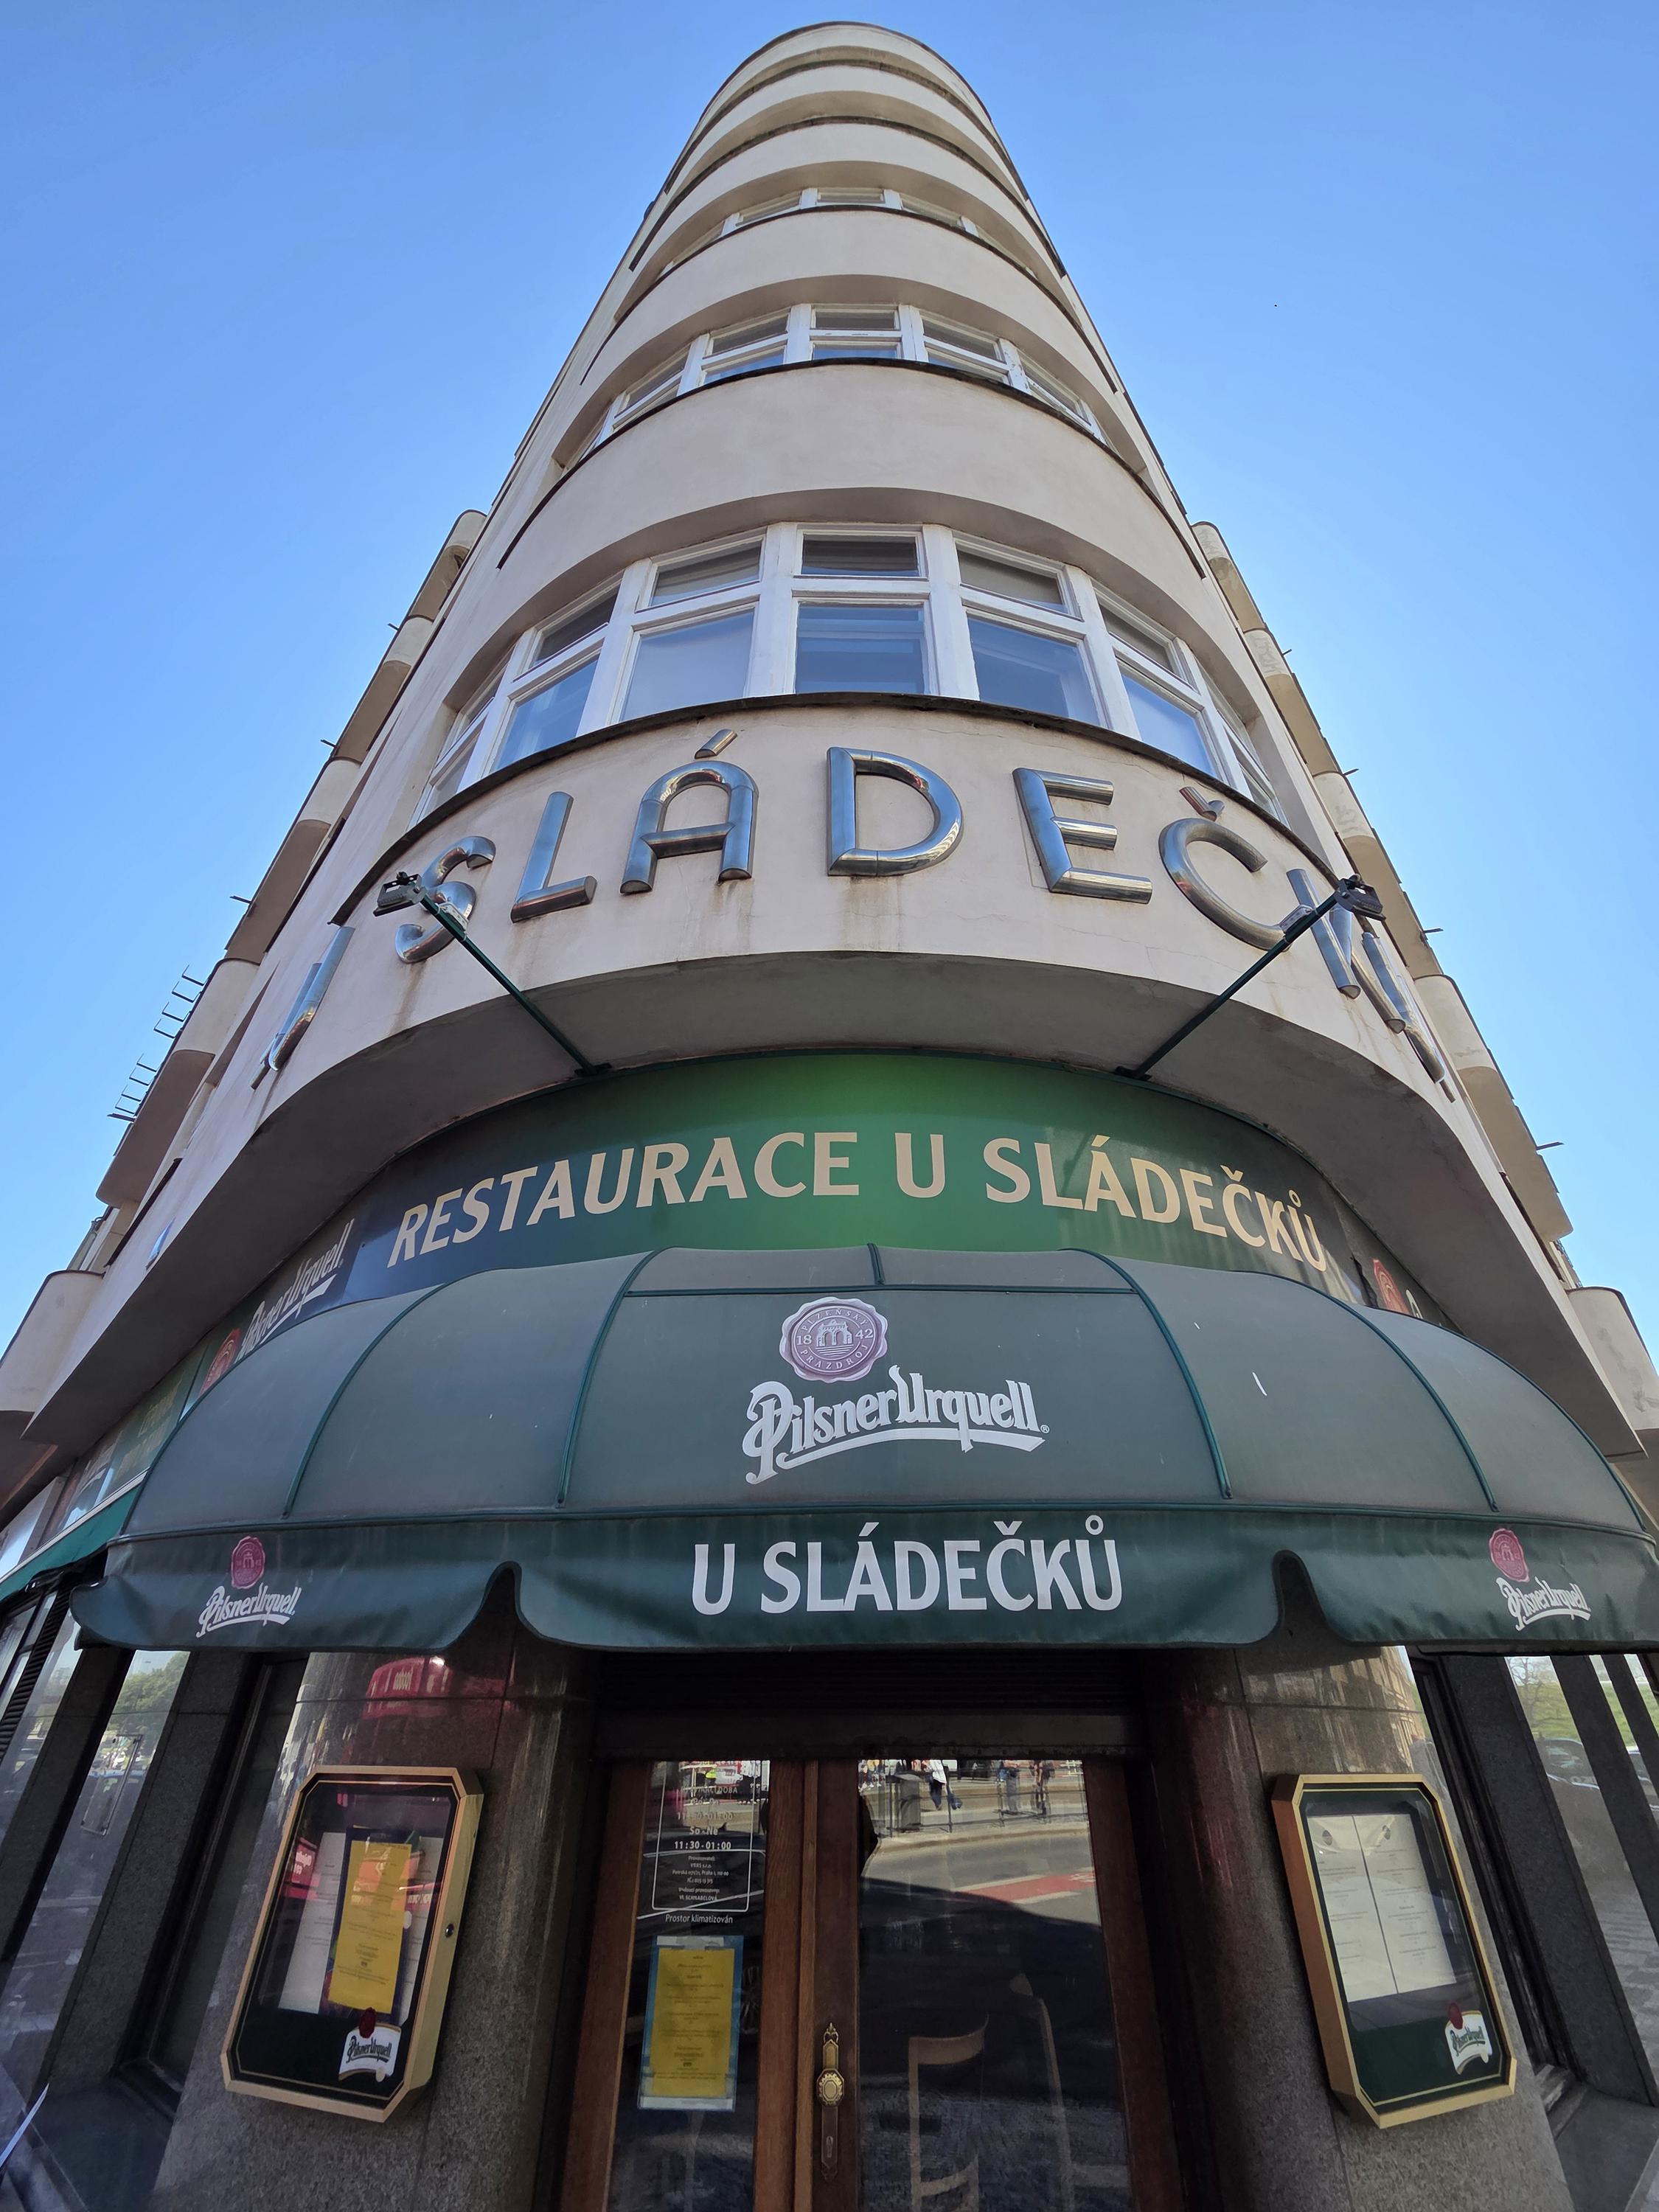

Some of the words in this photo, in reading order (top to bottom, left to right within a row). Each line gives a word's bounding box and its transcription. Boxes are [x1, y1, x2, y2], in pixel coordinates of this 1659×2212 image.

[386, 1132, 860, 1269] RESTAURACE
[894, 1133, 946, 1198] U
[983, 1135, 1328, 1272] SLÁDEČKŮ
[801, 1307, 869, 1331] PLZEŇSKÝ
[796, 1335, 812, 1346] 18
[855, 1329, 874, 1340] 42
[801, 1344, 869, 1369] PRAZDROJ
[692, 1543, 735, 1615] U
[761, 1514, 1122, 1614] SLÁDEČKŮ
[689, 1826, 700, 1835] So
[706, 1826, 719, 1836] Ne
[675, 1840, 700, 1849] 11:30
[706, 1841, 732, 1850] 01:00
[665, 1913, 690, 1922] Prostor
[691, 1913, 734, 1924] klimatizován
